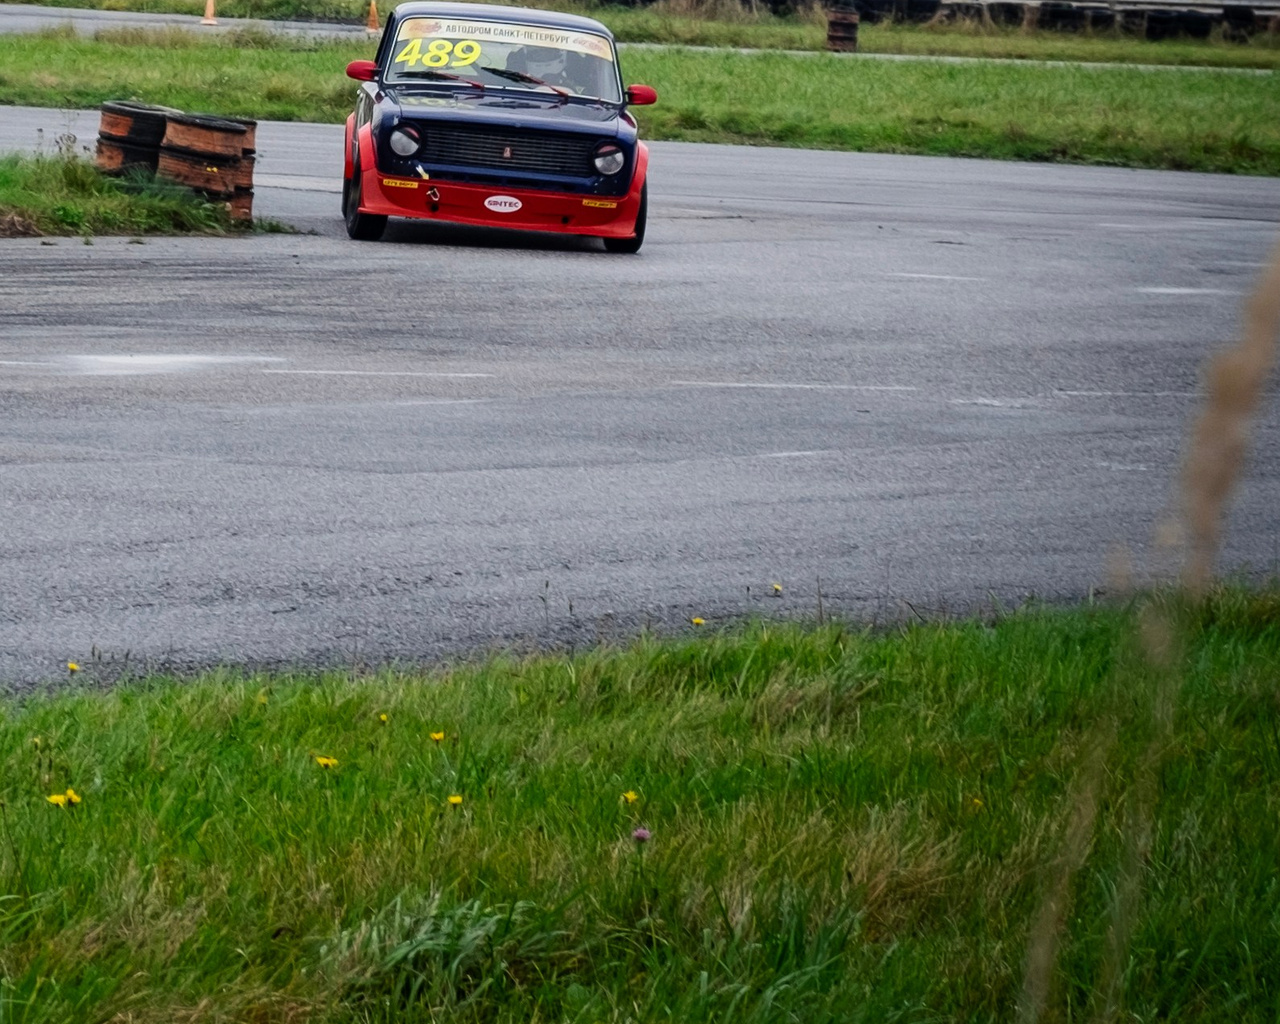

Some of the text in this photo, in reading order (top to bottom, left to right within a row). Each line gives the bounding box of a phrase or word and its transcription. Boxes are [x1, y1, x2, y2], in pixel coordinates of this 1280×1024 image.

[445, 24, 491, 35] АВТОДРОМ
[493, 27, 570, 44] САНКТ-ПЕТЕРБУРГ
[395, 39, 481, 67] 489
